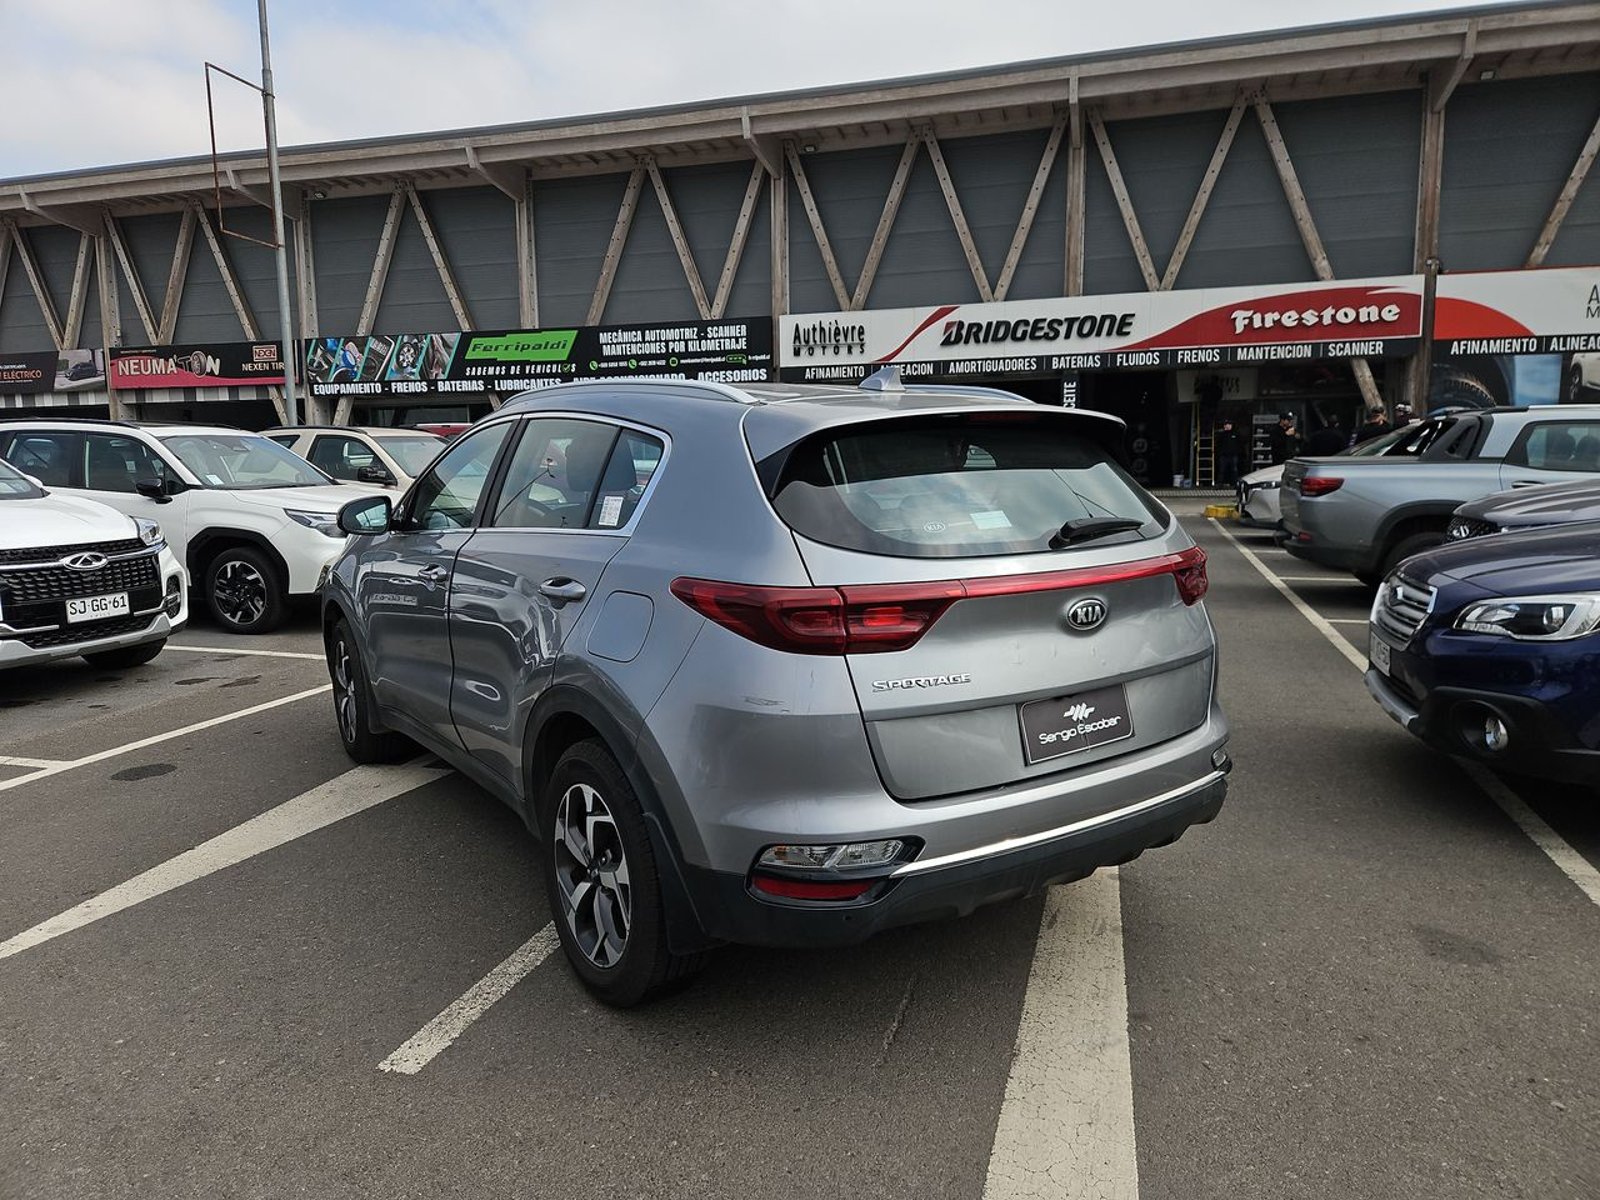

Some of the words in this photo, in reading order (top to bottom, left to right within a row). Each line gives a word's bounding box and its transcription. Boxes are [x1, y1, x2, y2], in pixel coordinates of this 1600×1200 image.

[1230, 303, 1401, 335] Firestone
[599, 329, 642, 344] MECÁNICA
[644, 327, 698, 341] AUTOMOTRIZ
[706, 324, 747, 338] SCANNER
[793, 319, 865, 345] Authièvre
[940, 312, 1136, 347] BRIDGESTONE
[472, 340, 568, 352] Ferripaldi
[602, 341, 666, 356] MANTENCIONES
[668, 340, 686, 353] POR
[687, 337, 747, 352] KILOMETRAJE
[793, 343, 865, 357] MOTORS
[1450, 338, 1538, 355] AFINAMIENTO
[242, 363, 270, 372] NEXEN
[271, 362, 285, 370] TIR
[804, 365, 865, 380] AFINAMIENTO
[880, 362, 934, 376] EACION
[948, 357, 1037, 374] AMORTIGUADORES
[1051, 353, 1101, 369] BATERIAS
[1116, 351, 1160, 367] FLUIDOS
[1177, 348, 1221, 364] FRENOS
[1236, 344, 1313, 361] MANTENCION
[1328, 341, 1384, 357] SCANNER
[465, 365, 506, 376] SABEMOS
[510, 365, 520, 375] DE
[698, 368, 767, 382] ACCESORIOS
[313, 382, 382, 395] EQUIPAMIENTO
[391, 381, 428, 393] FRENOS
[437, 380, 485, 392] BATERIAS
[1063, 381, 1077, 410] CEITE
[1076, 605, 1102, 623] KIA
[872, 672, 971, 692] SPORTAGE
[1077, 716, 1122, 735] Escobar
